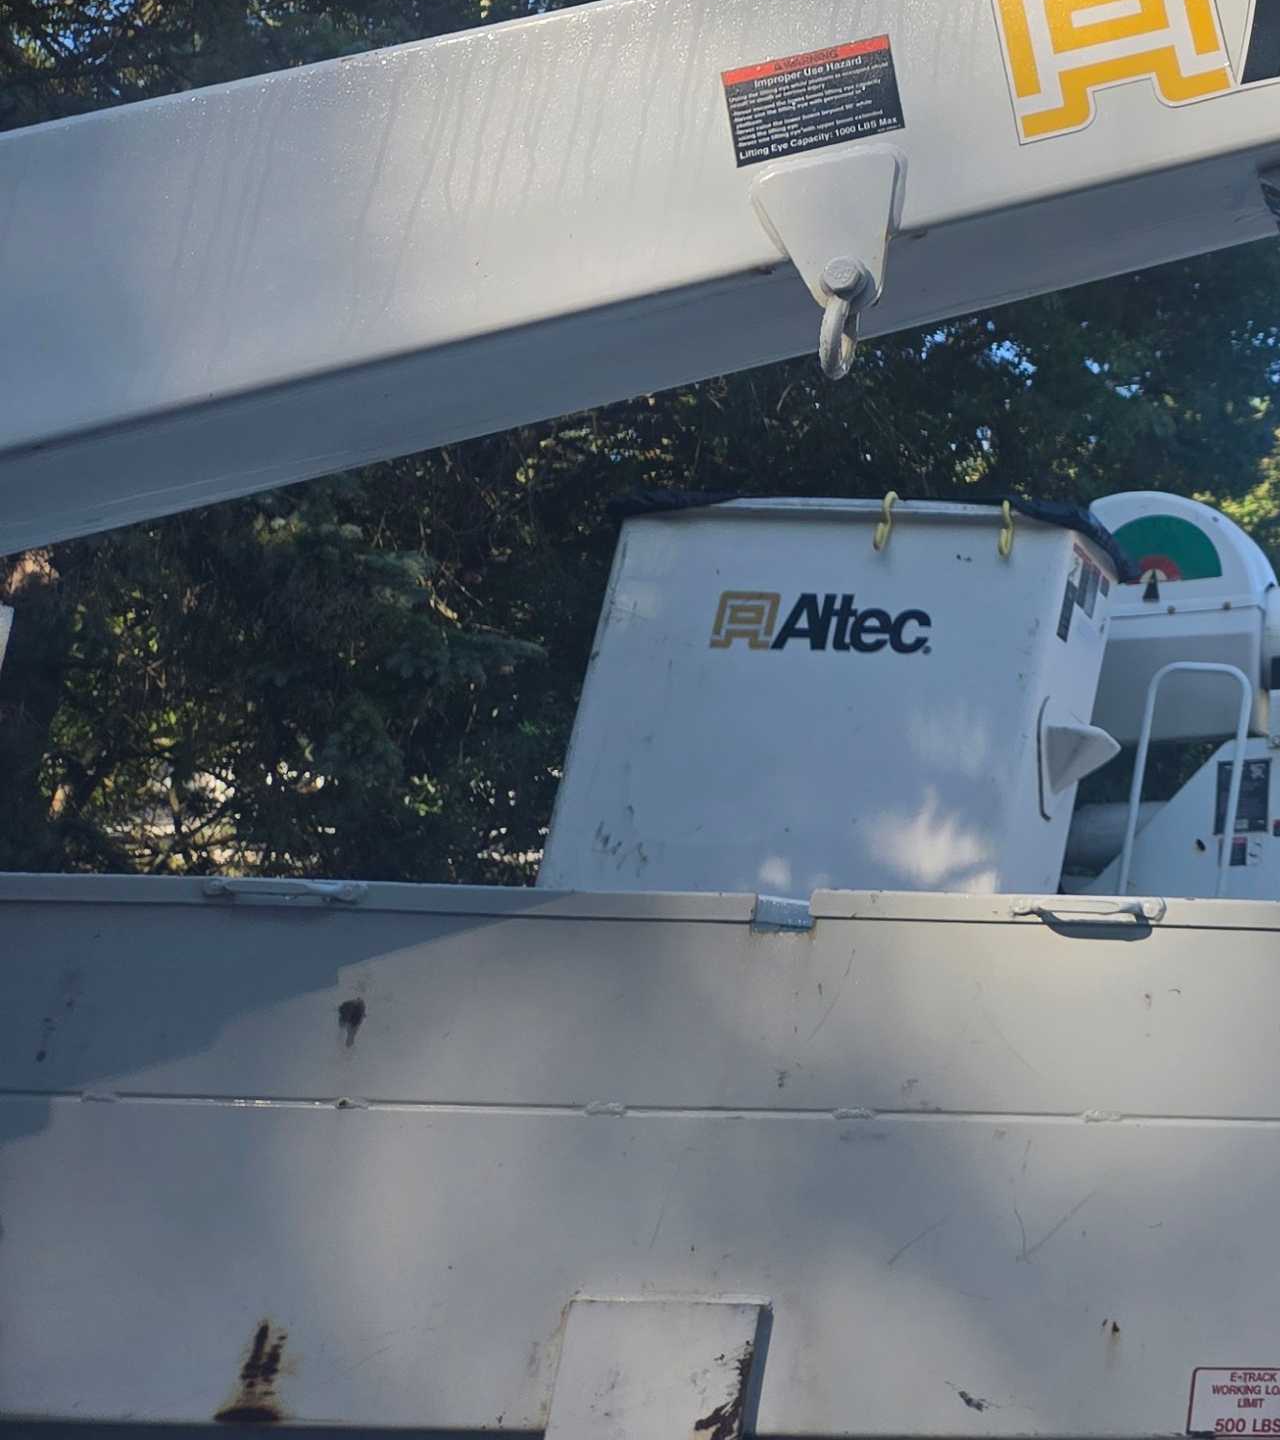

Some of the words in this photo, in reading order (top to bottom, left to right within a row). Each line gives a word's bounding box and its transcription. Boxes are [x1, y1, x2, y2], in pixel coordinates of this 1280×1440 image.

[754, 70, 801, 89] Improper
[804, 66, 823, 77] Use
[826, 57, 862, 73] Hazard
[739, 145, 769, 160] Lifting
[771, 141, 788, 153] Eye
[790, 131, 833, 149] Capacity:
[835, 126, 856, 138] 1000
[858, 121, 877, 133] LBS
[879, 116, 897, 128] Max
[770, 593, 932, 654] Altec
[1230, 1372, 1277, 1382] E-TRACK
[1212, 1385, 1261, 1395] WORKING
[1237, 1398, 1265, 1408] LIMIT
[1214, 1418, 1246, 1432] 500
